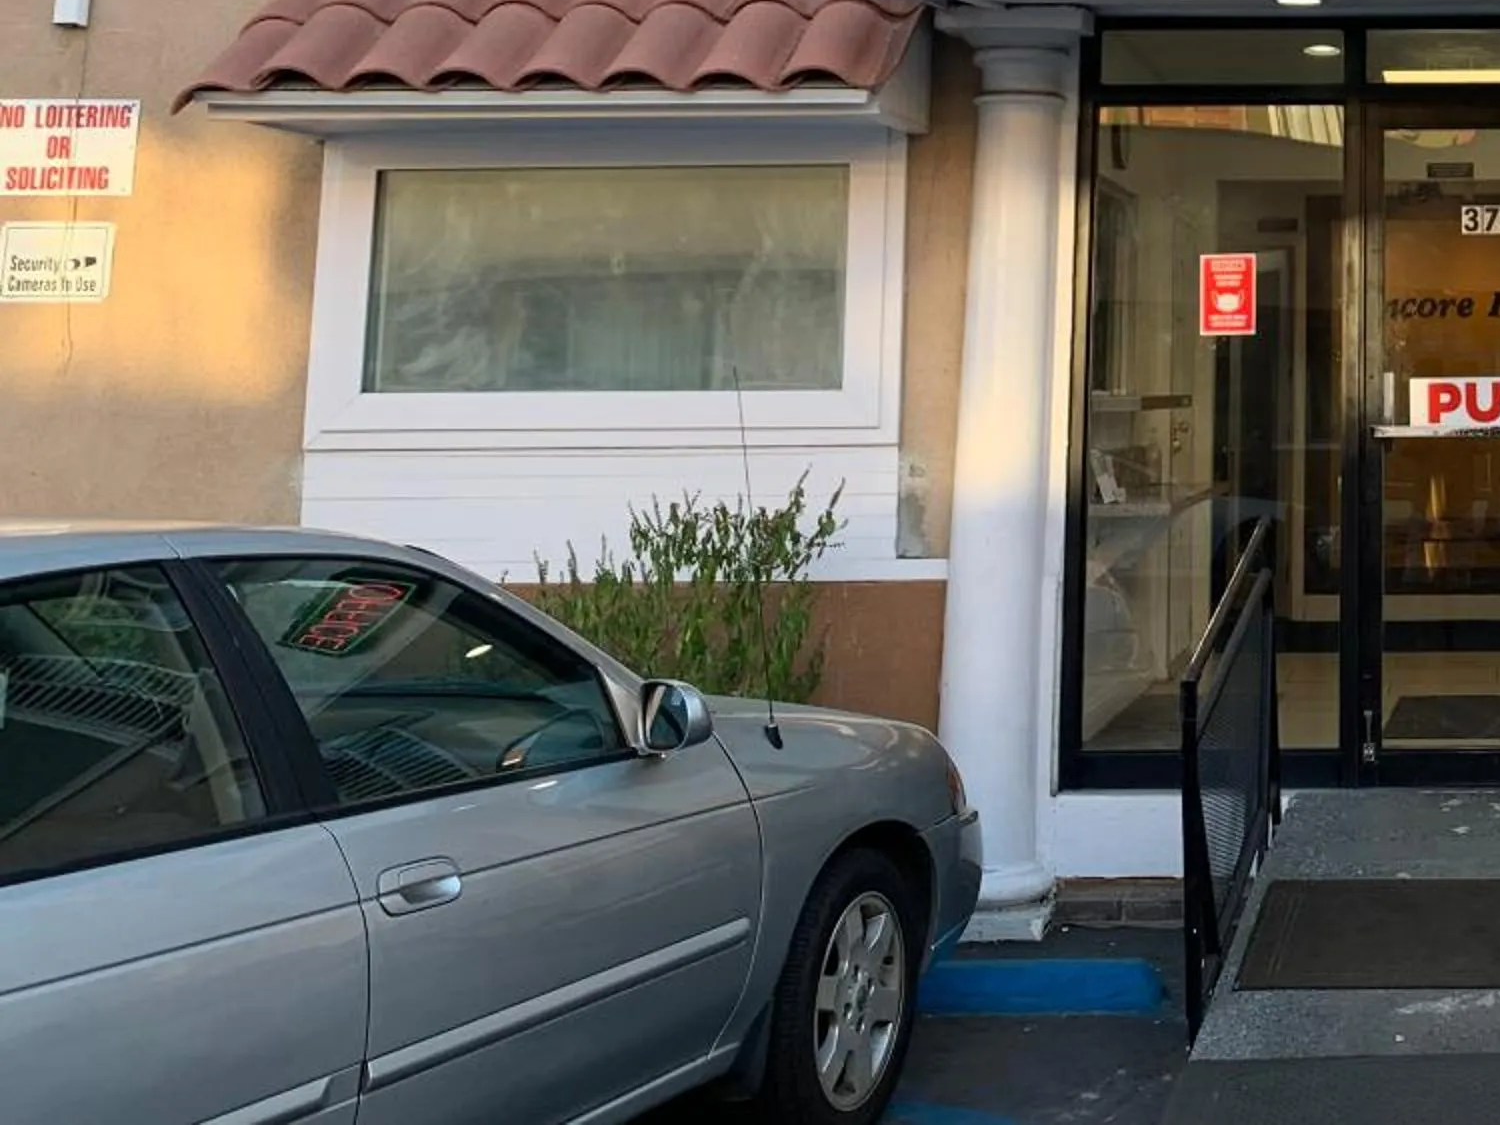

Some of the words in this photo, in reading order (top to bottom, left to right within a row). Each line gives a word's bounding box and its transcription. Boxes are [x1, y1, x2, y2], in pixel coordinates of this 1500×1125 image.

[0, 104, 25, 128] NO
[35, 104, 131, 128] LOITERING
[46, 135, 71, 160] OR
[5, 166, 109, 191] SOLICITING
[10, 255, 59, 275] Security
[8, 275, 57, 292] Cameras
[76, 276, 96, 292] Use
